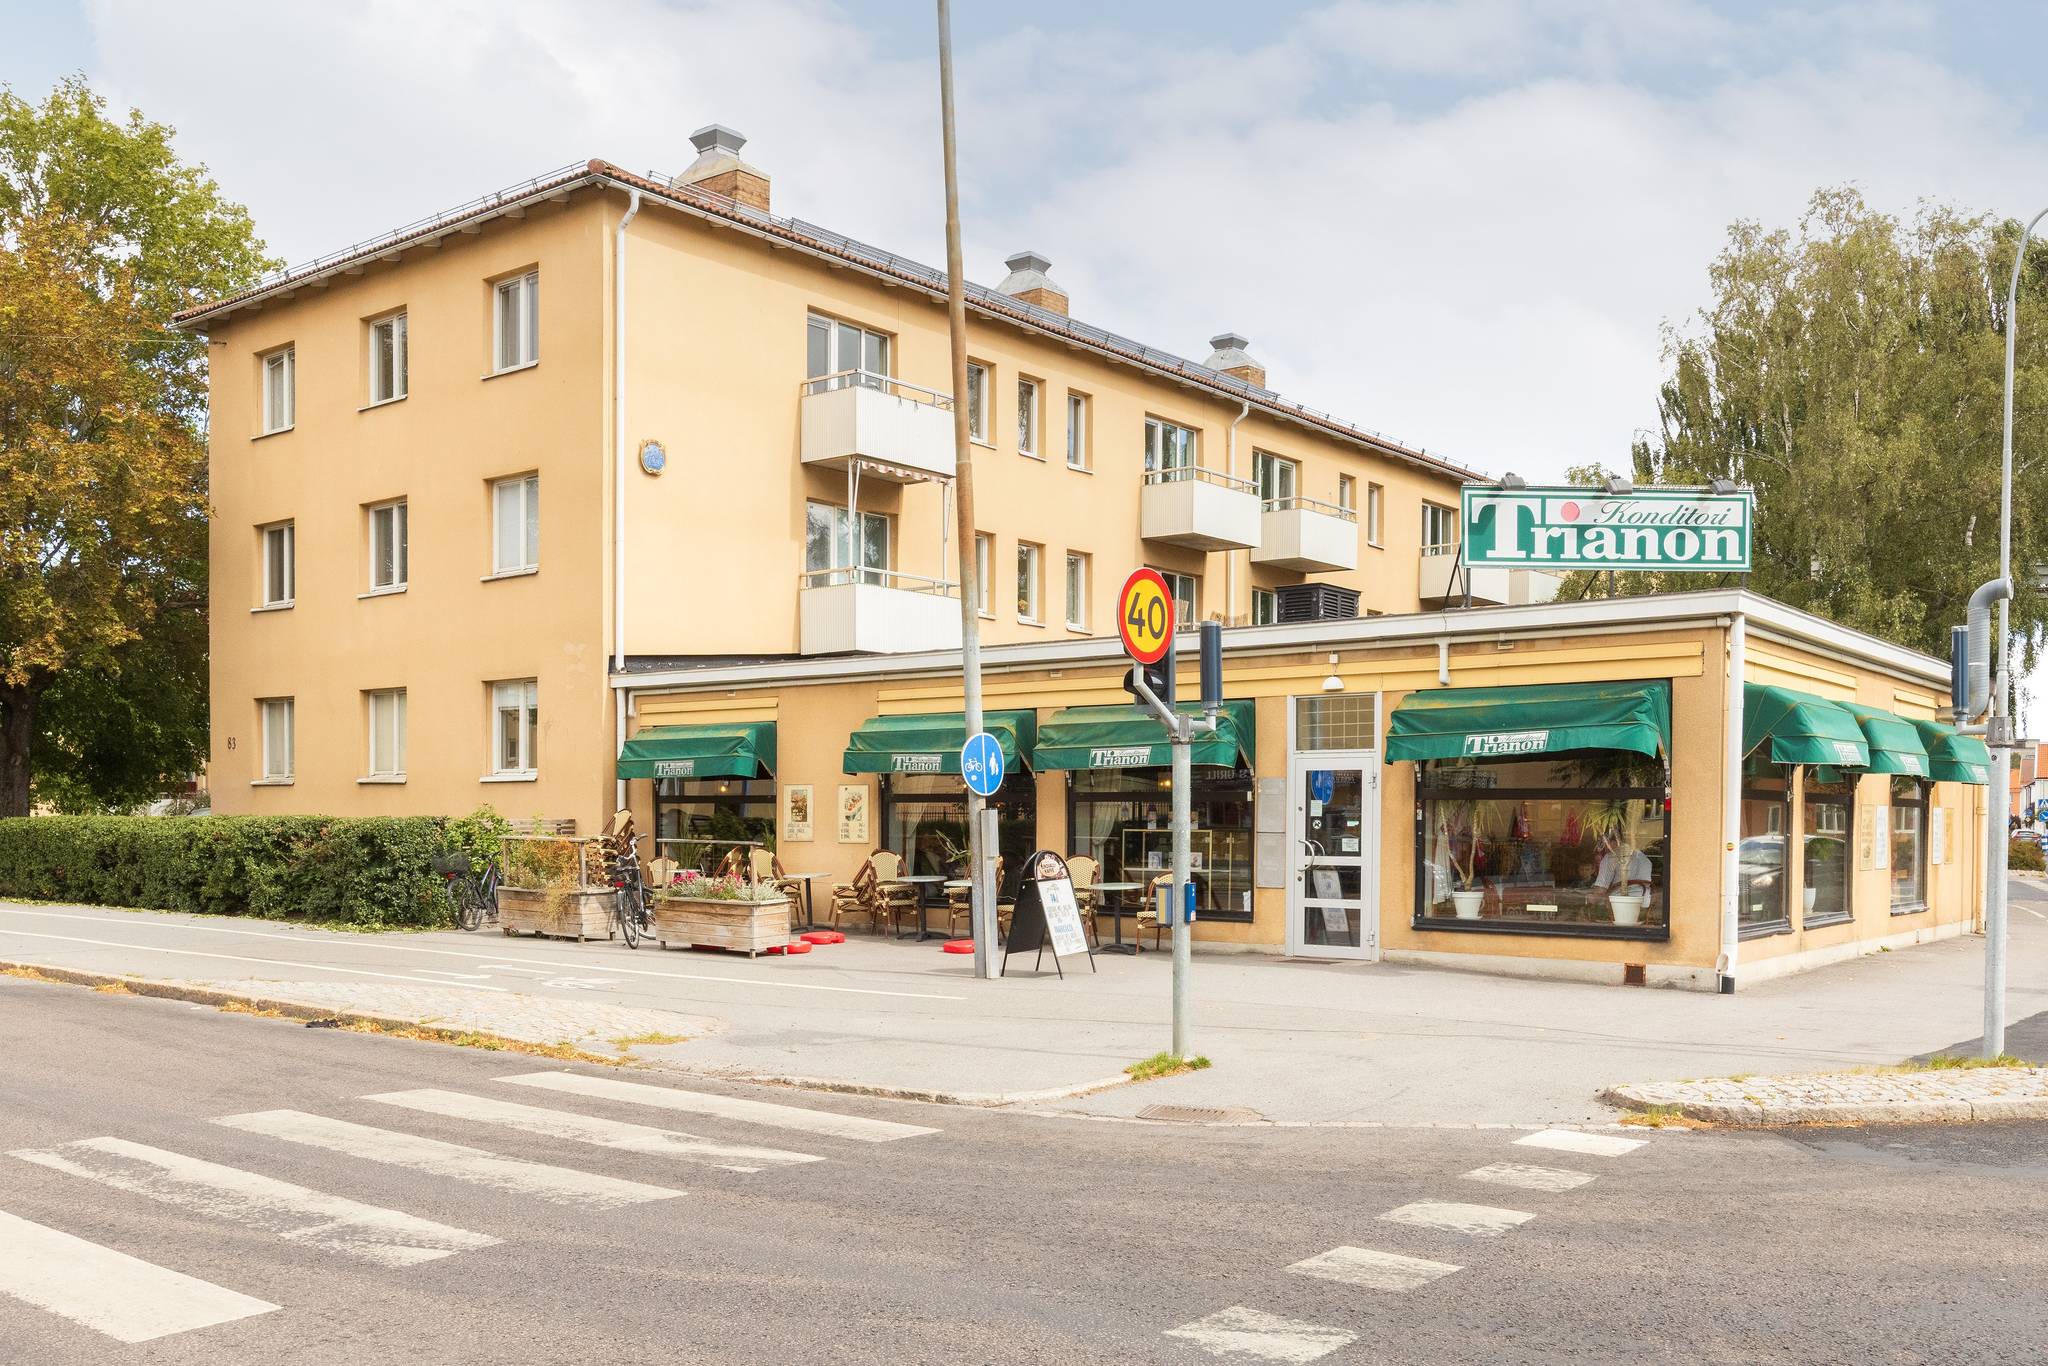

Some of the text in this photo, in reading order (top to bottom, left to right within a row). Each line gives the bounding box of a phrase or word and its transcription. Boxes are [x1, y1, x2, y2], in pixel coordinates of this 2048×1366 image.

[1594, 500, 1732, 526] Konditori
[1471, 496, 1743, 561] Trianon
[1127, 591, 1166, 640] 40
[227, 736, 237, 750] 83
[1467, 736, 1545, 754] Trianon
[892, 756, 940, 771] Trianon
[1091, 750, 1148, 767] Trianon
[655, 763, 694, 776] Trianon
